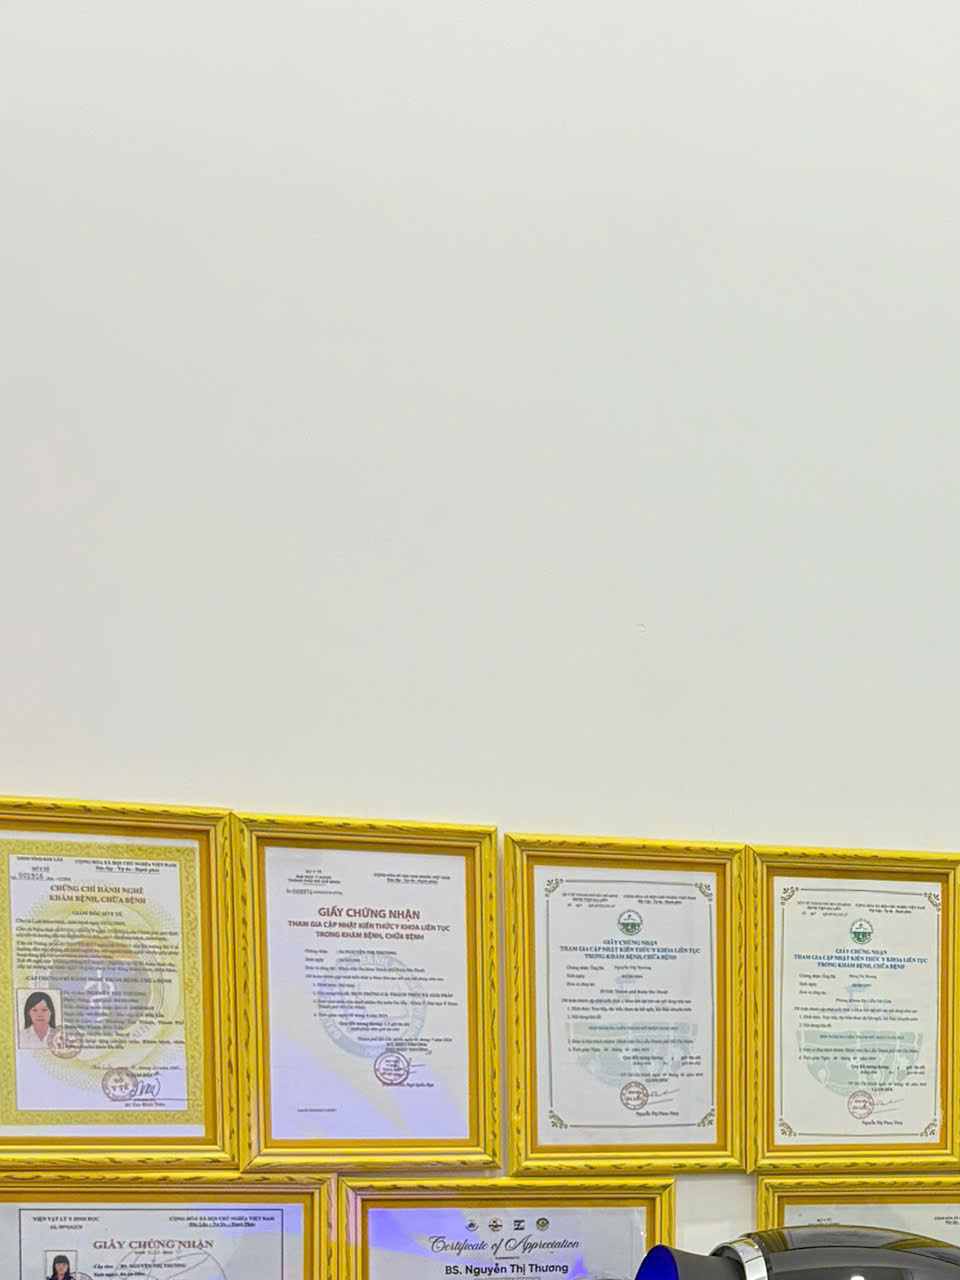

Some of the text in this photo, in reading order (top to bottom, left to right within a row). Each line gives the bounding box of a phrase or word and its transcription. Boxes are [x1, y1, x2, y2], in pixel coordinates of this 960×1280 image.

[318, 905, 420, 922] GIẤY CHỨNG NHẬN
[429, 1234, 580, 1256] Certificate of Appreciation
[445, 1263, 569, 1276] BS. Nguyễn Thị Thương
